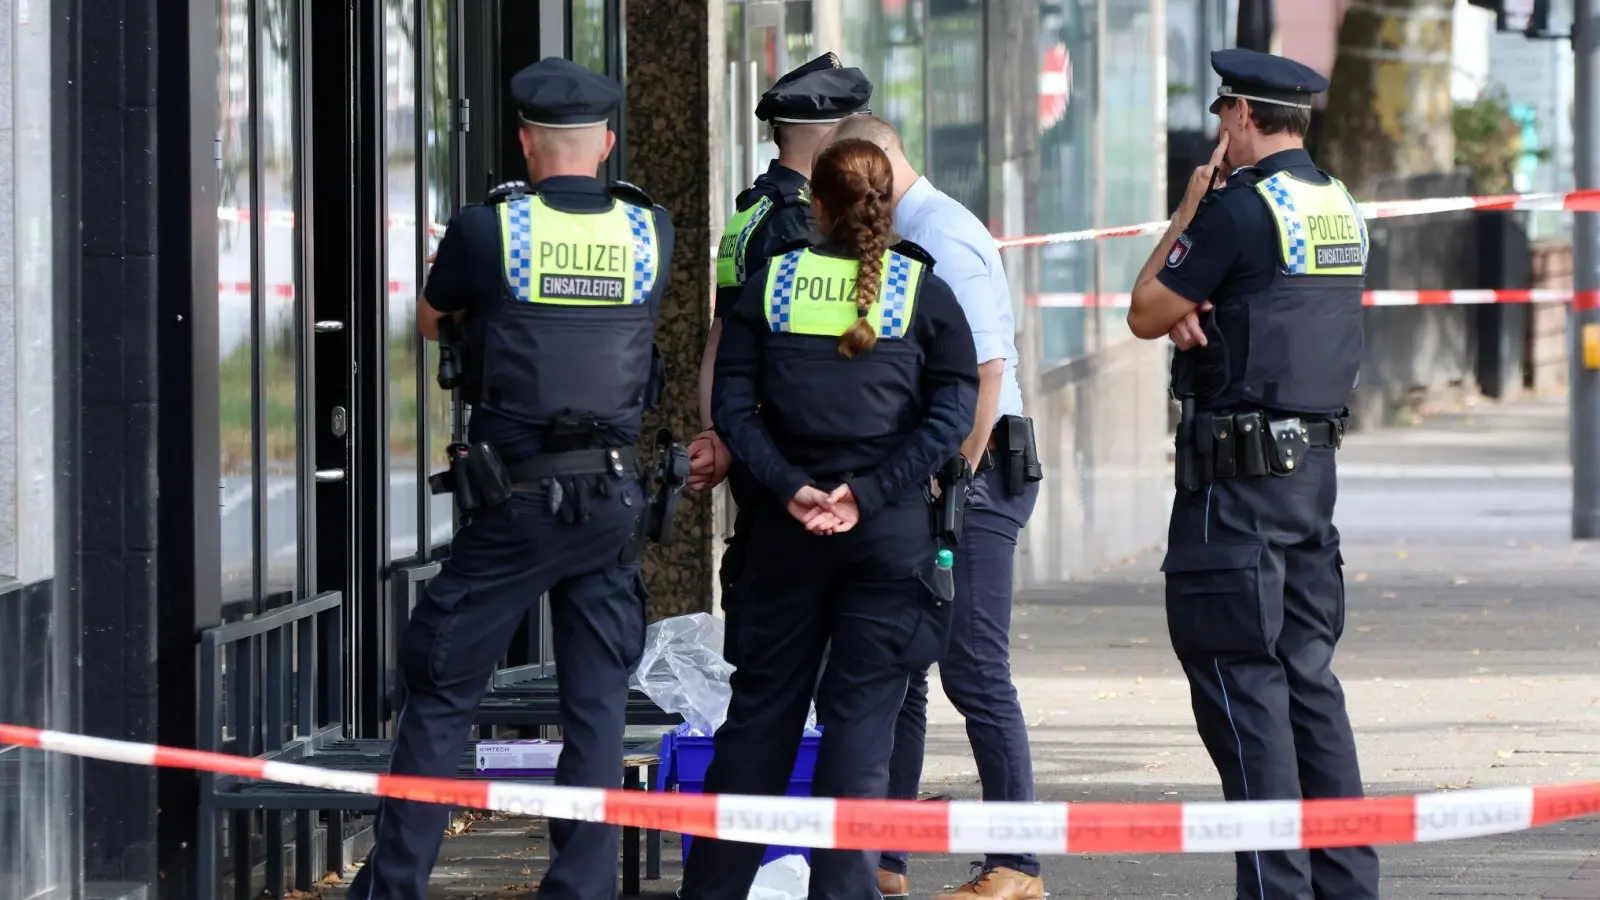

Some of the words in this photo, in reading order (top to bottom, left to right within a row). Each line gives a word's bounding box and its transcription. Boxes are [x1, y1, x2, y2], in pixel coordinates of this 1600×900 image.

[1307, 214, 1359, 241] POLIZEI
[540, 241, 627, 273] POLIZEI
[543, 276, 622, 298] EINSATZLEITER
[795, 276, 882, 304] POLIZI
